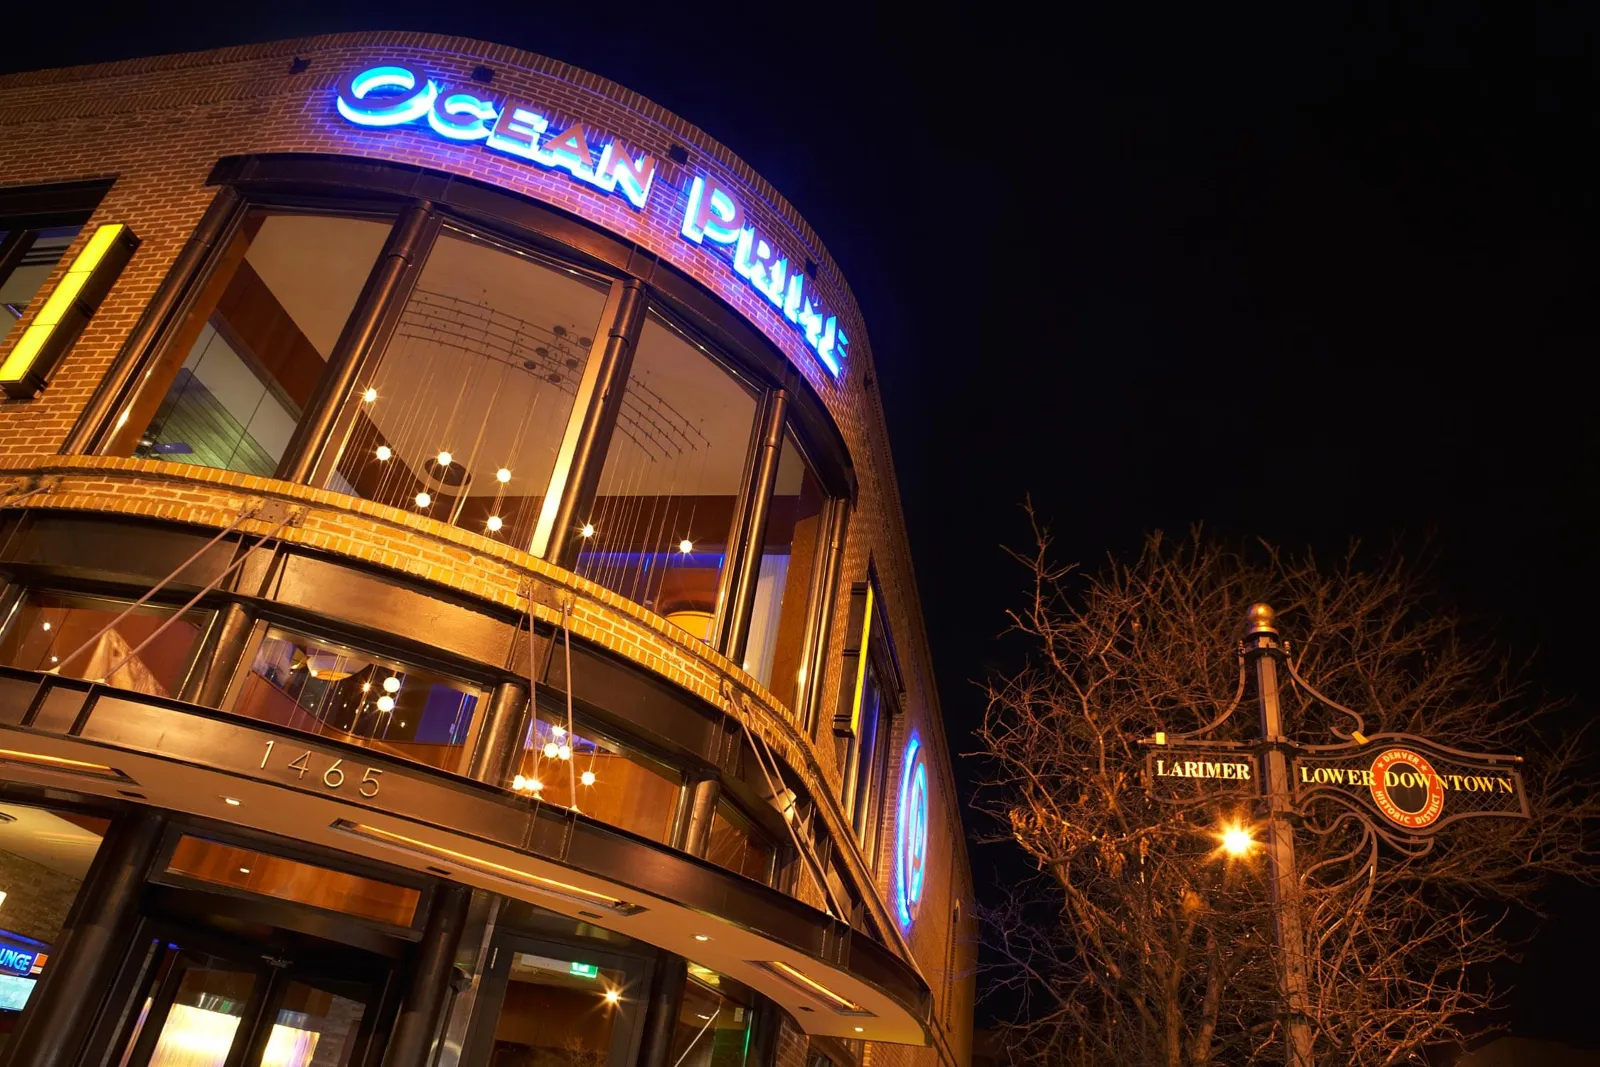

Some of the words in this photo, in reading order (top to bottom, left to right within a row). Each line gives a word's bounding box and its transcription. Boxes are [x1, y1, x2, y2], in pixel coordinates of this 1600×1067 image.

[336, 64, 655, 211] OCEAN
[680, 174, 849, 379] PRIME
[260, 740, 383, 797] 1465
[1156, 760, 1251, 780] LARIMER
[1382, 751, 1420, 765] DENVER
[1301, 766, 1377, 787] LOWER
[1384, 771, 1513, 794] DOWNTOWN
[1375, 790, 1410, 824] HISTORIC
[1414, 793, 1441, 825] DISTRICT
